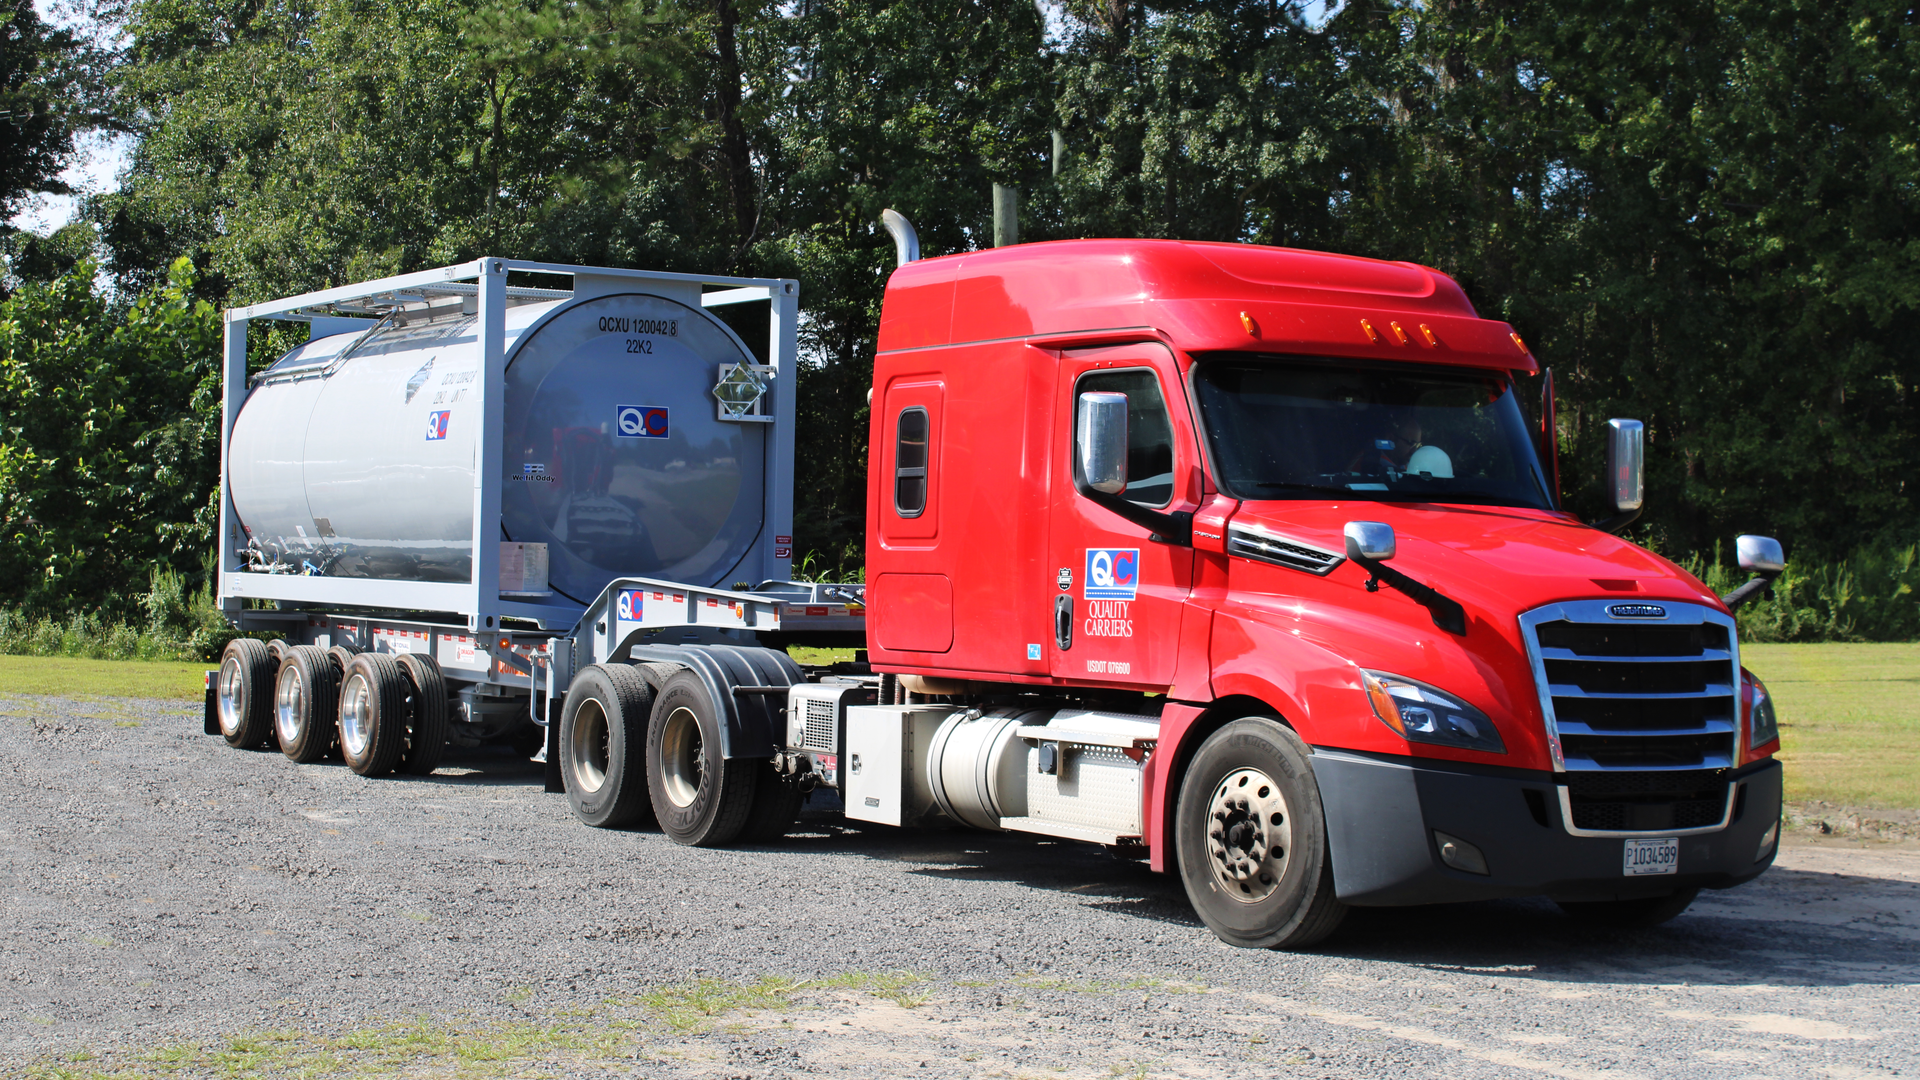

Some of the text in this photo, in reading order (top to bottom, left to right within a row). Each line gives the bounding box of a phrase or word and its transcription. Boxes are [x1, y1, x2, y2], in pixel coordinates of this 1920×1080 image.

[598, 316, 630, 333] QCXU
[632, 318, 668, 335] 120042
[626, 339, 653, 355] 22K2
[427, 411, 450, 439] QC
[619, 408, 668, 435] QC
[512, 474, 556, 483] Welfit Oddy
[1091, 550, 1134, 587] QC
[618, 591, 643, 621] QC
[1089, 600, 1130, 619] QUALITY
[1613, 606, 1664, 615] FREIGHTLINER
[1084, 618, 1133, 637] CARRIERS
[461, 648, 475, 656] DRAGON
[1086, 660, 1131, 675] USDOT 076600
[650, 689, 679, 747] ENDURANCE
[1246, 735, 1296, 780] MICHELIN
[1627, 845, 1678, 866] P1034589
